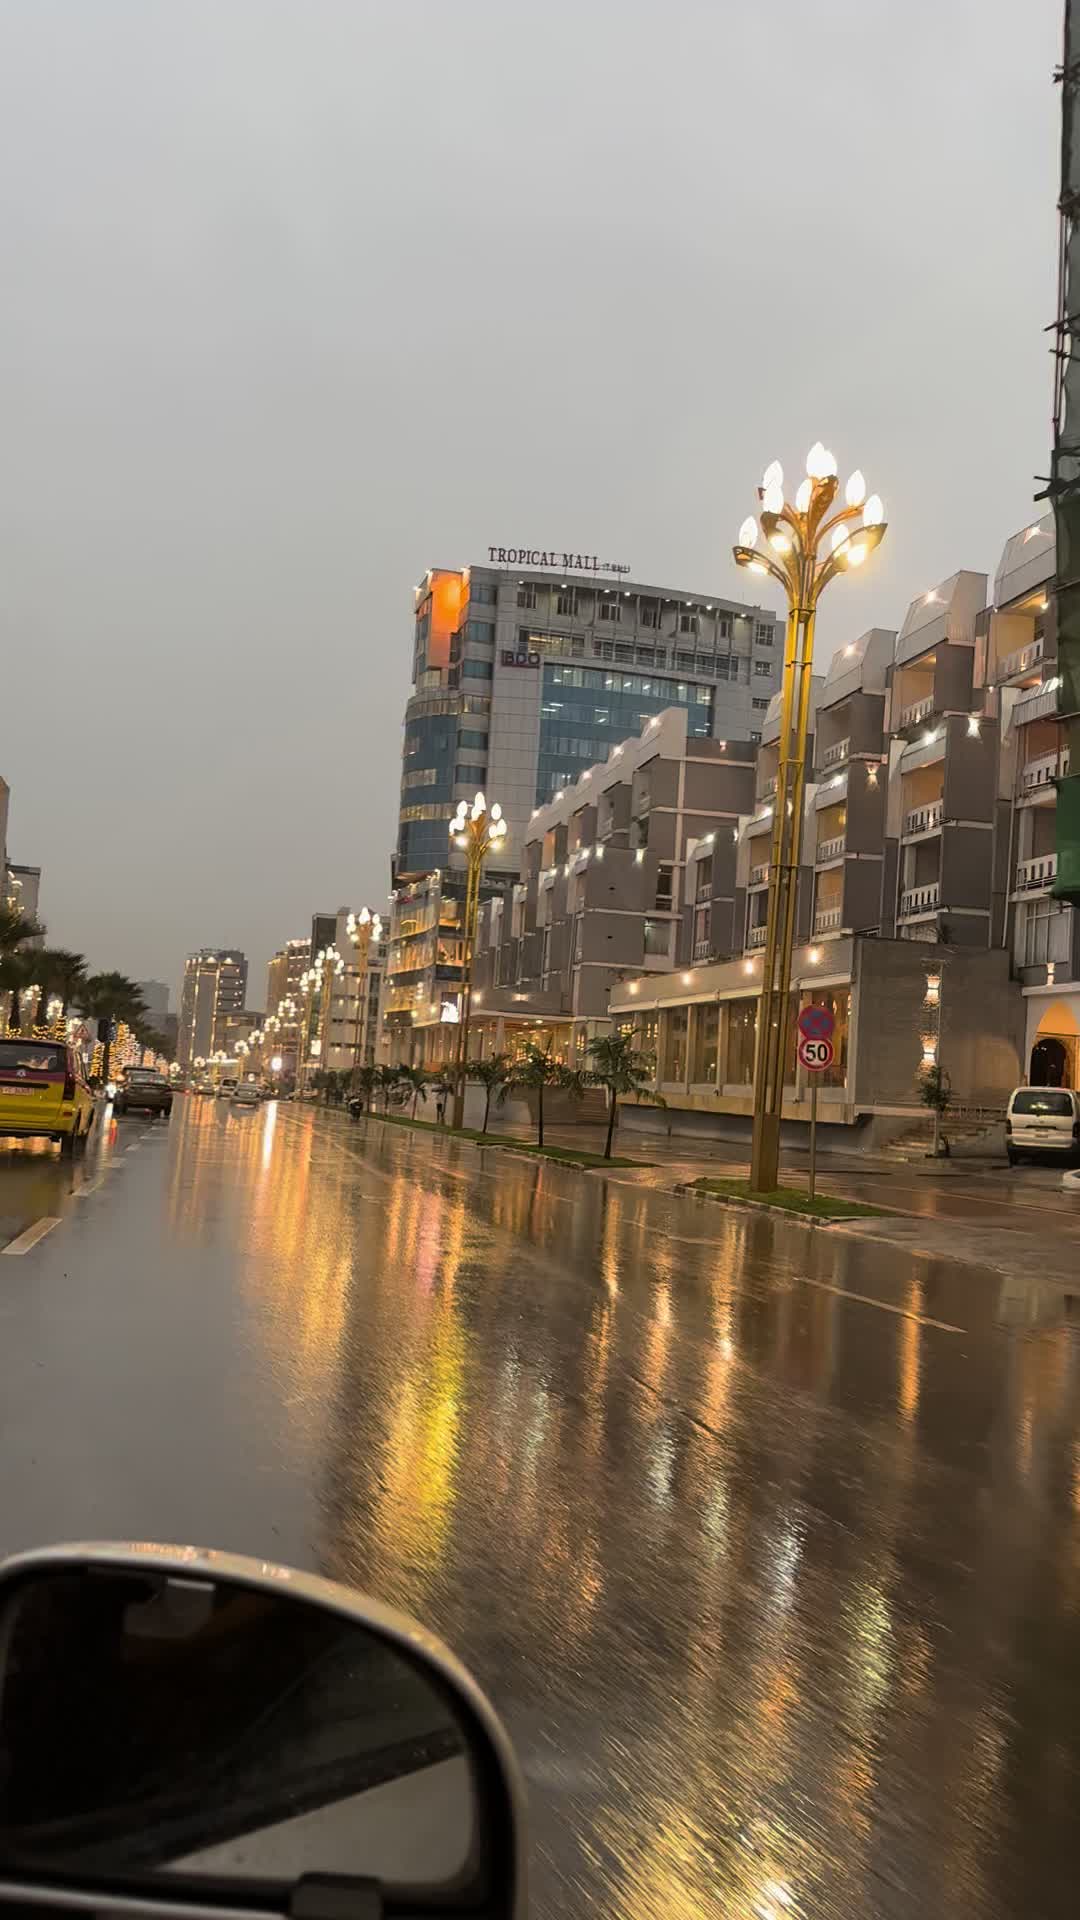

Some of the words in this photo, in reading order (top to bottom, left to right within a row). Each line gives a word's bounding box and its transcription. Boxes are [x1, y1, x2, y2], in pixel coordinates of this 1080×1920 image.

[488, 547, 558, 566] TROPICAL
[562, 554, 600, 570] MALL
[806, 1044, 828, 1062] 50
